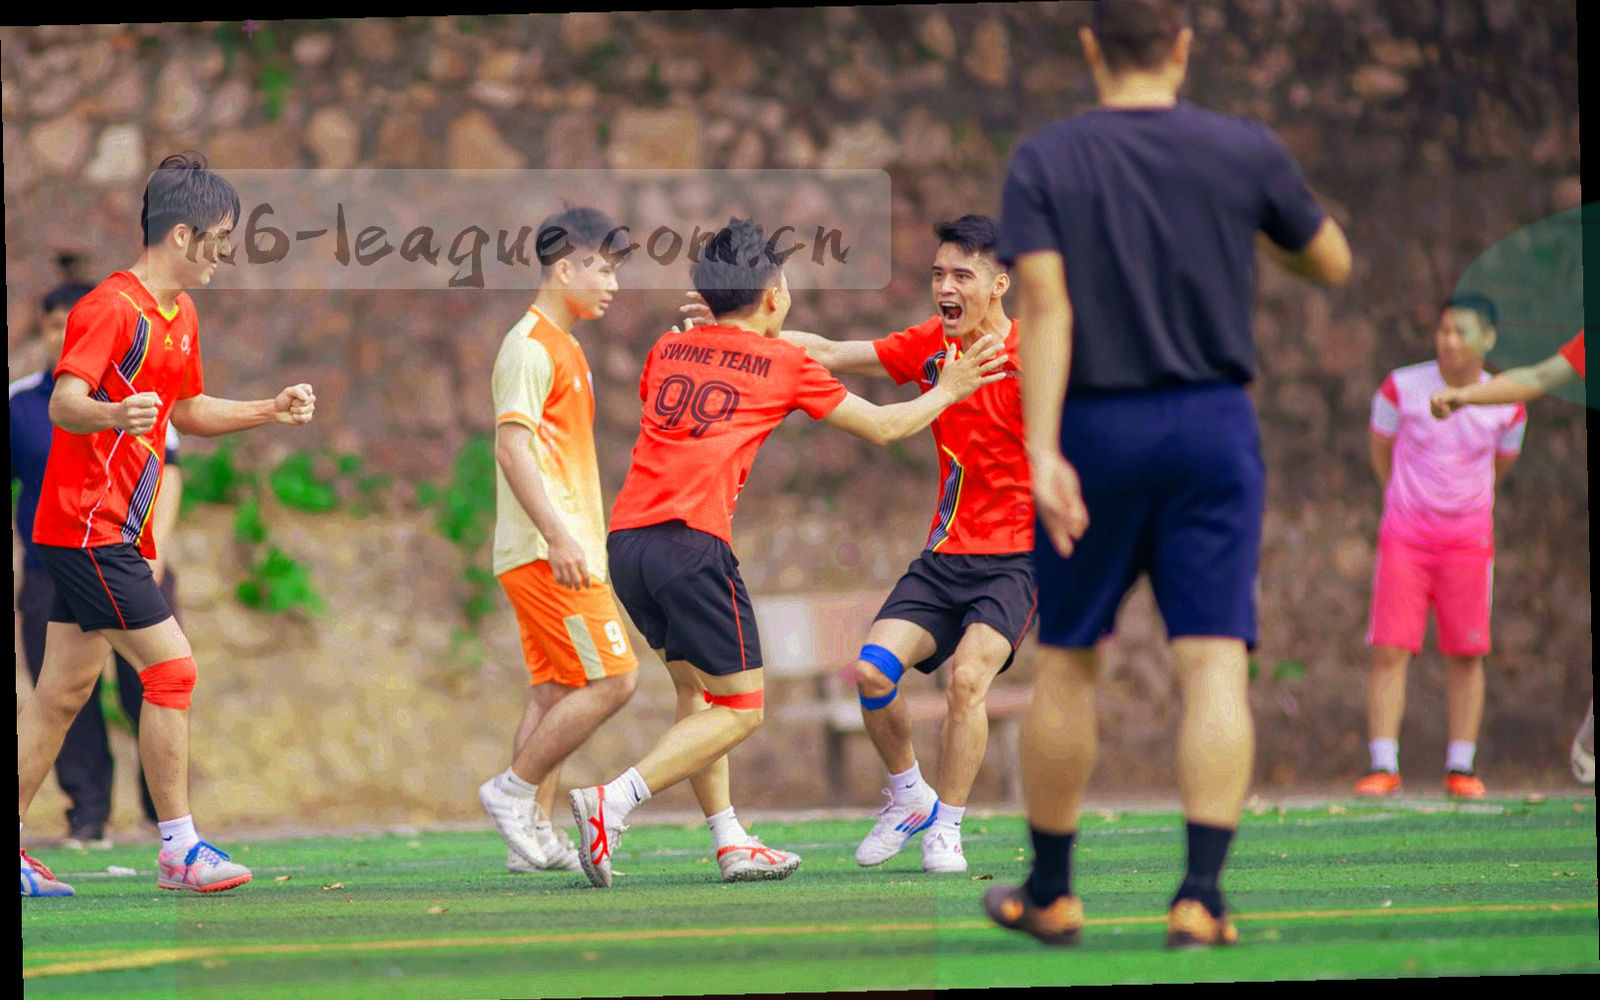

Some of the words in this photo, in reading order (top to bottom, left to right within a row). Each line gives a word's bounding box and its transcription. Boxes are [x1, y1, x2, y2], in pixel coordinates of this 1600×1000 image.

[660, 343, 716, 365] SWINE
[719, 350, 772, 378] TEAM
[654, 374, 740, 438] 99
[604, 619, 628, 656] 9
